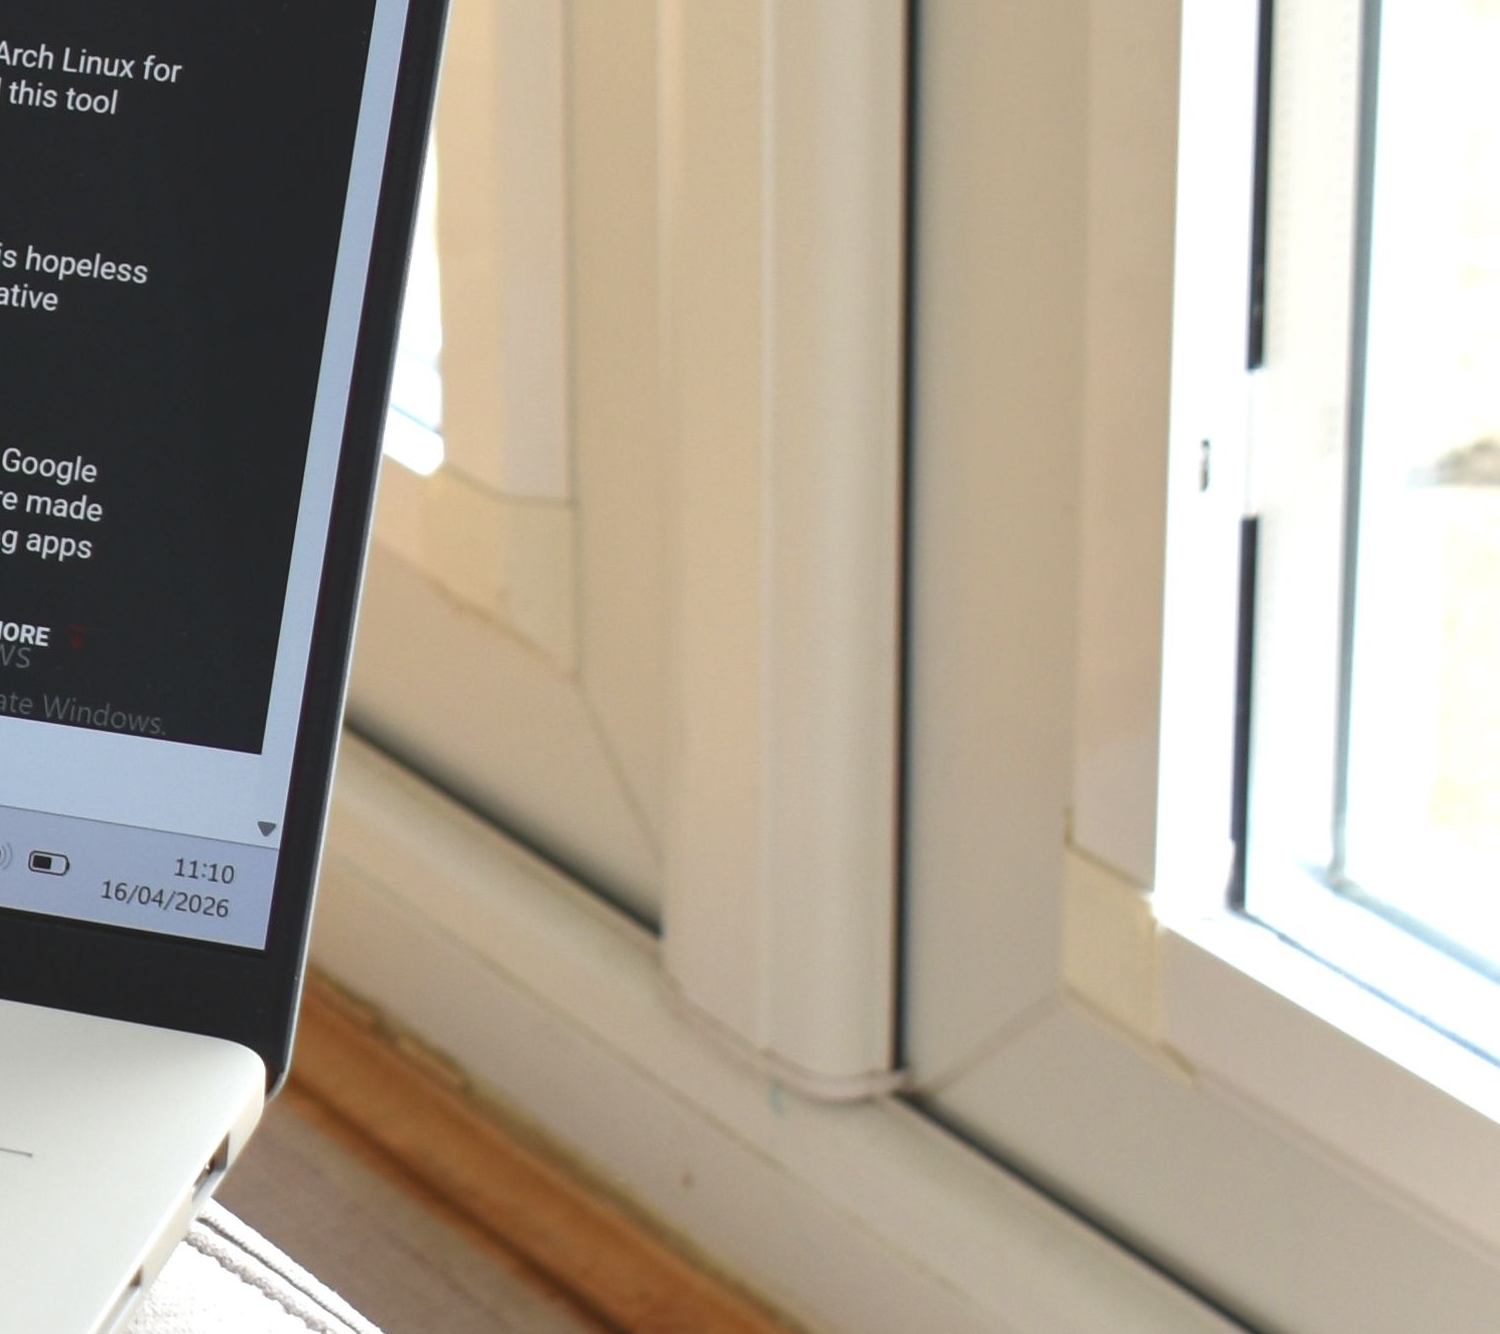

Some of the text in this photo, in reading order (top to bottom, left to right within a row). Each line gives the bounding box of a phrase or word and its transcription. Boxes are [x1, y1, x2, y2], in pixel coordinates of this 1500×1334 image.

[1, 447, 98, 486] Google
[25, 494, 103, 522] made
[25, 533, 93, 562] apps
[41, 693, 168, 737] Windows.
[174, 858, 235, 885] 11:10
[101, 880, 230, 919] 16/04/2026
